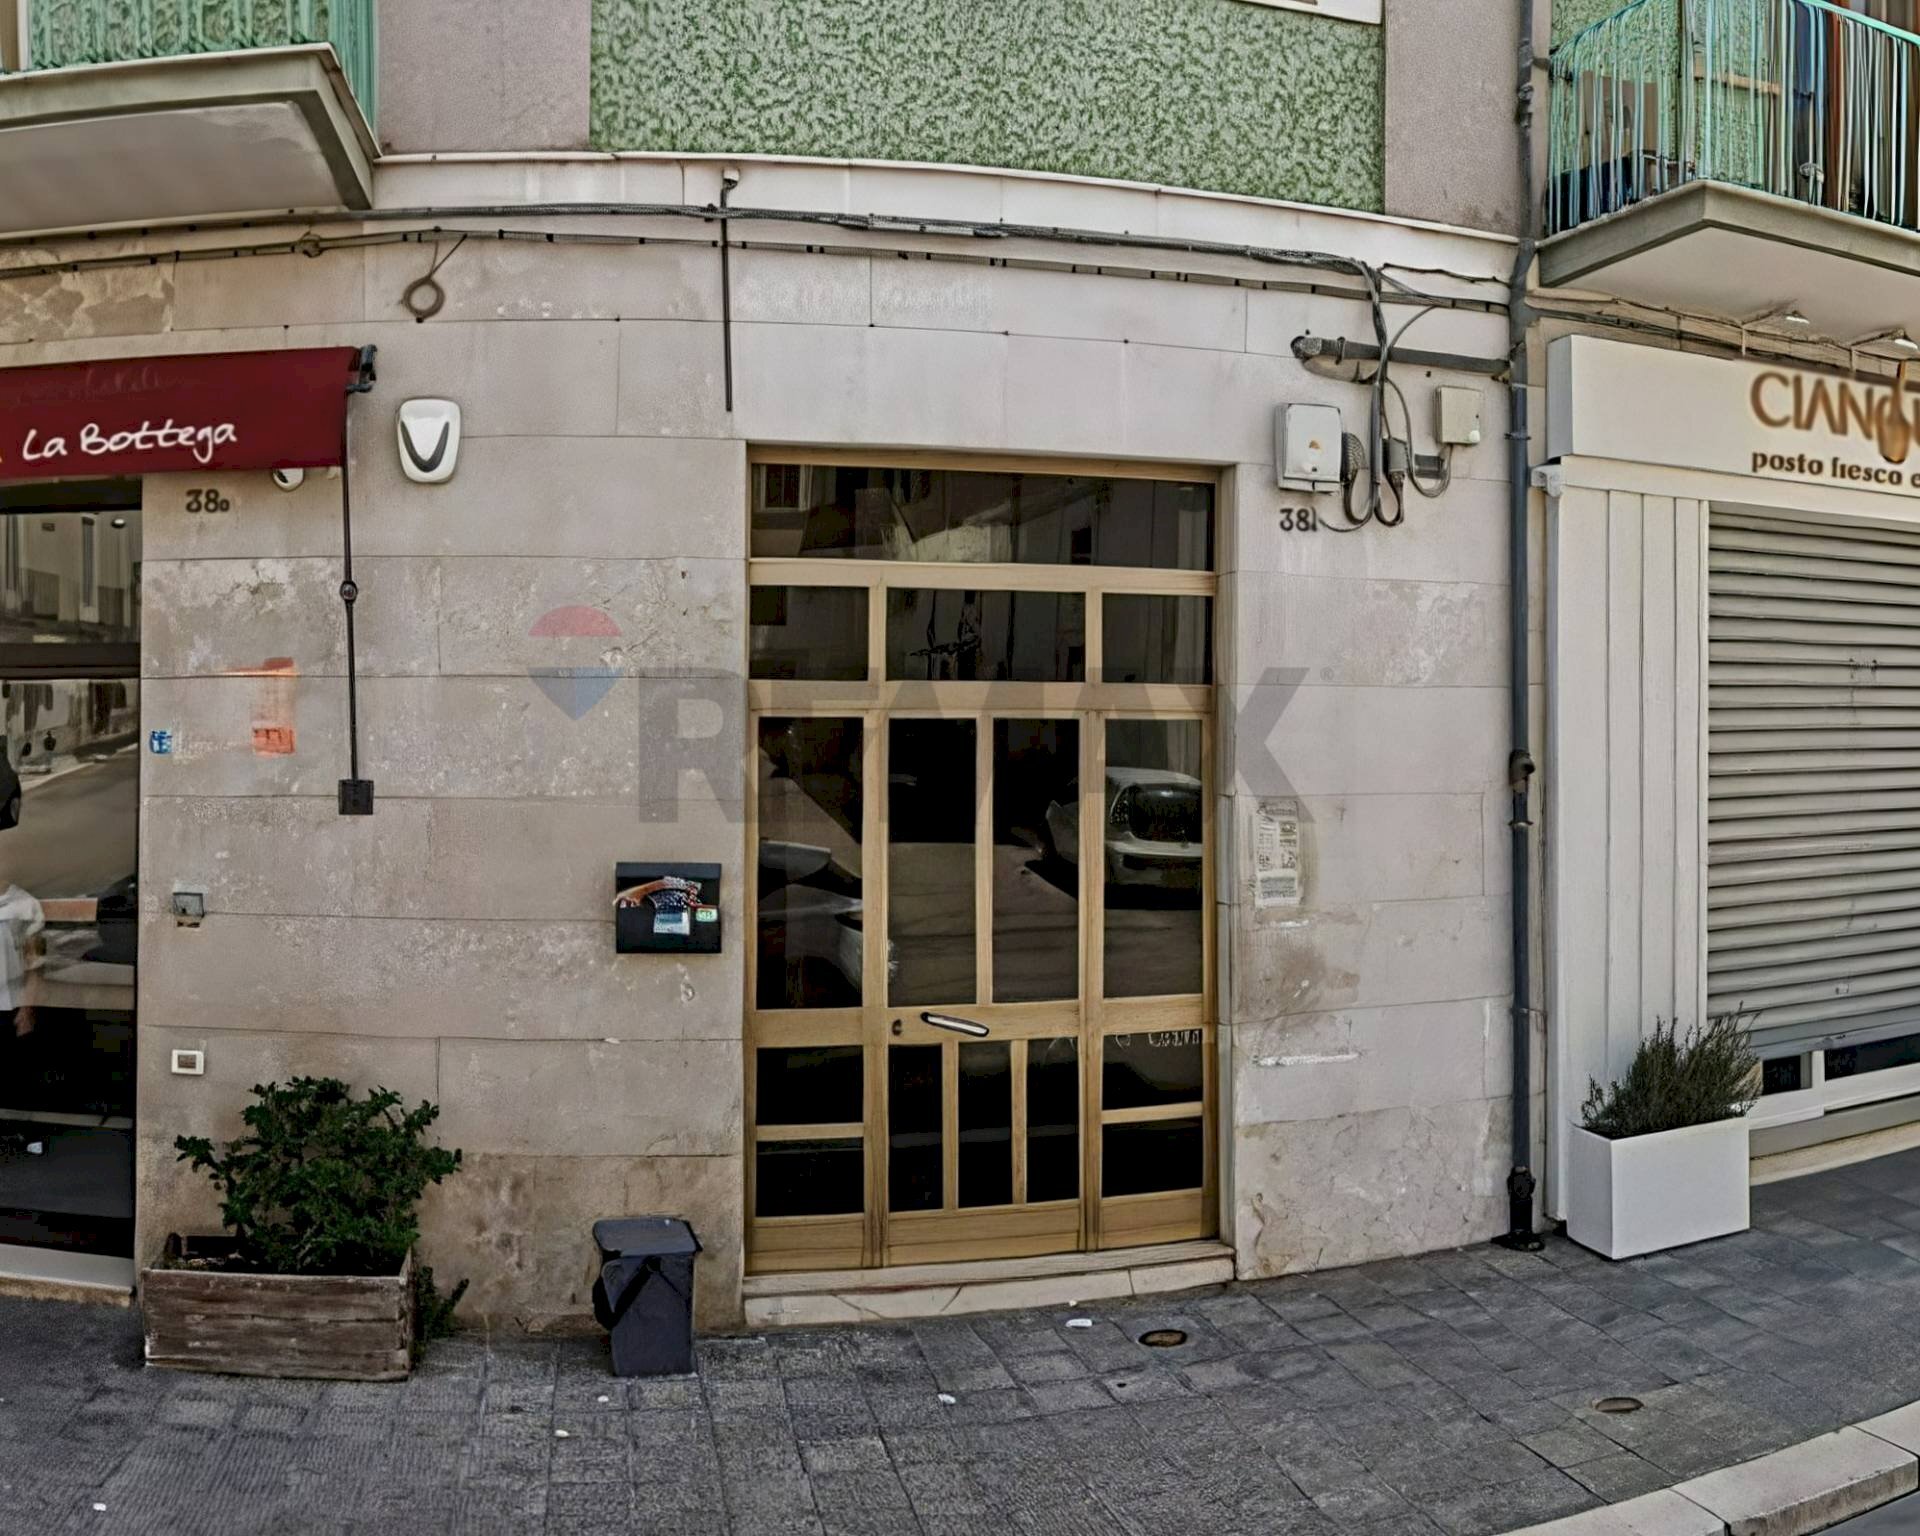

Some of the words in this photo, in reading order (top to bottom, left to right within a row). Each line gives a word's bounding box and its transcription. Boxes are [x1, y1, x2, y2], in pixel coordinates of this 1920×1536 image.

[22, 429, 68, 460] La
[80, 418, 237, 463] Bottega
[1752, 452, 1824, 474] posto
